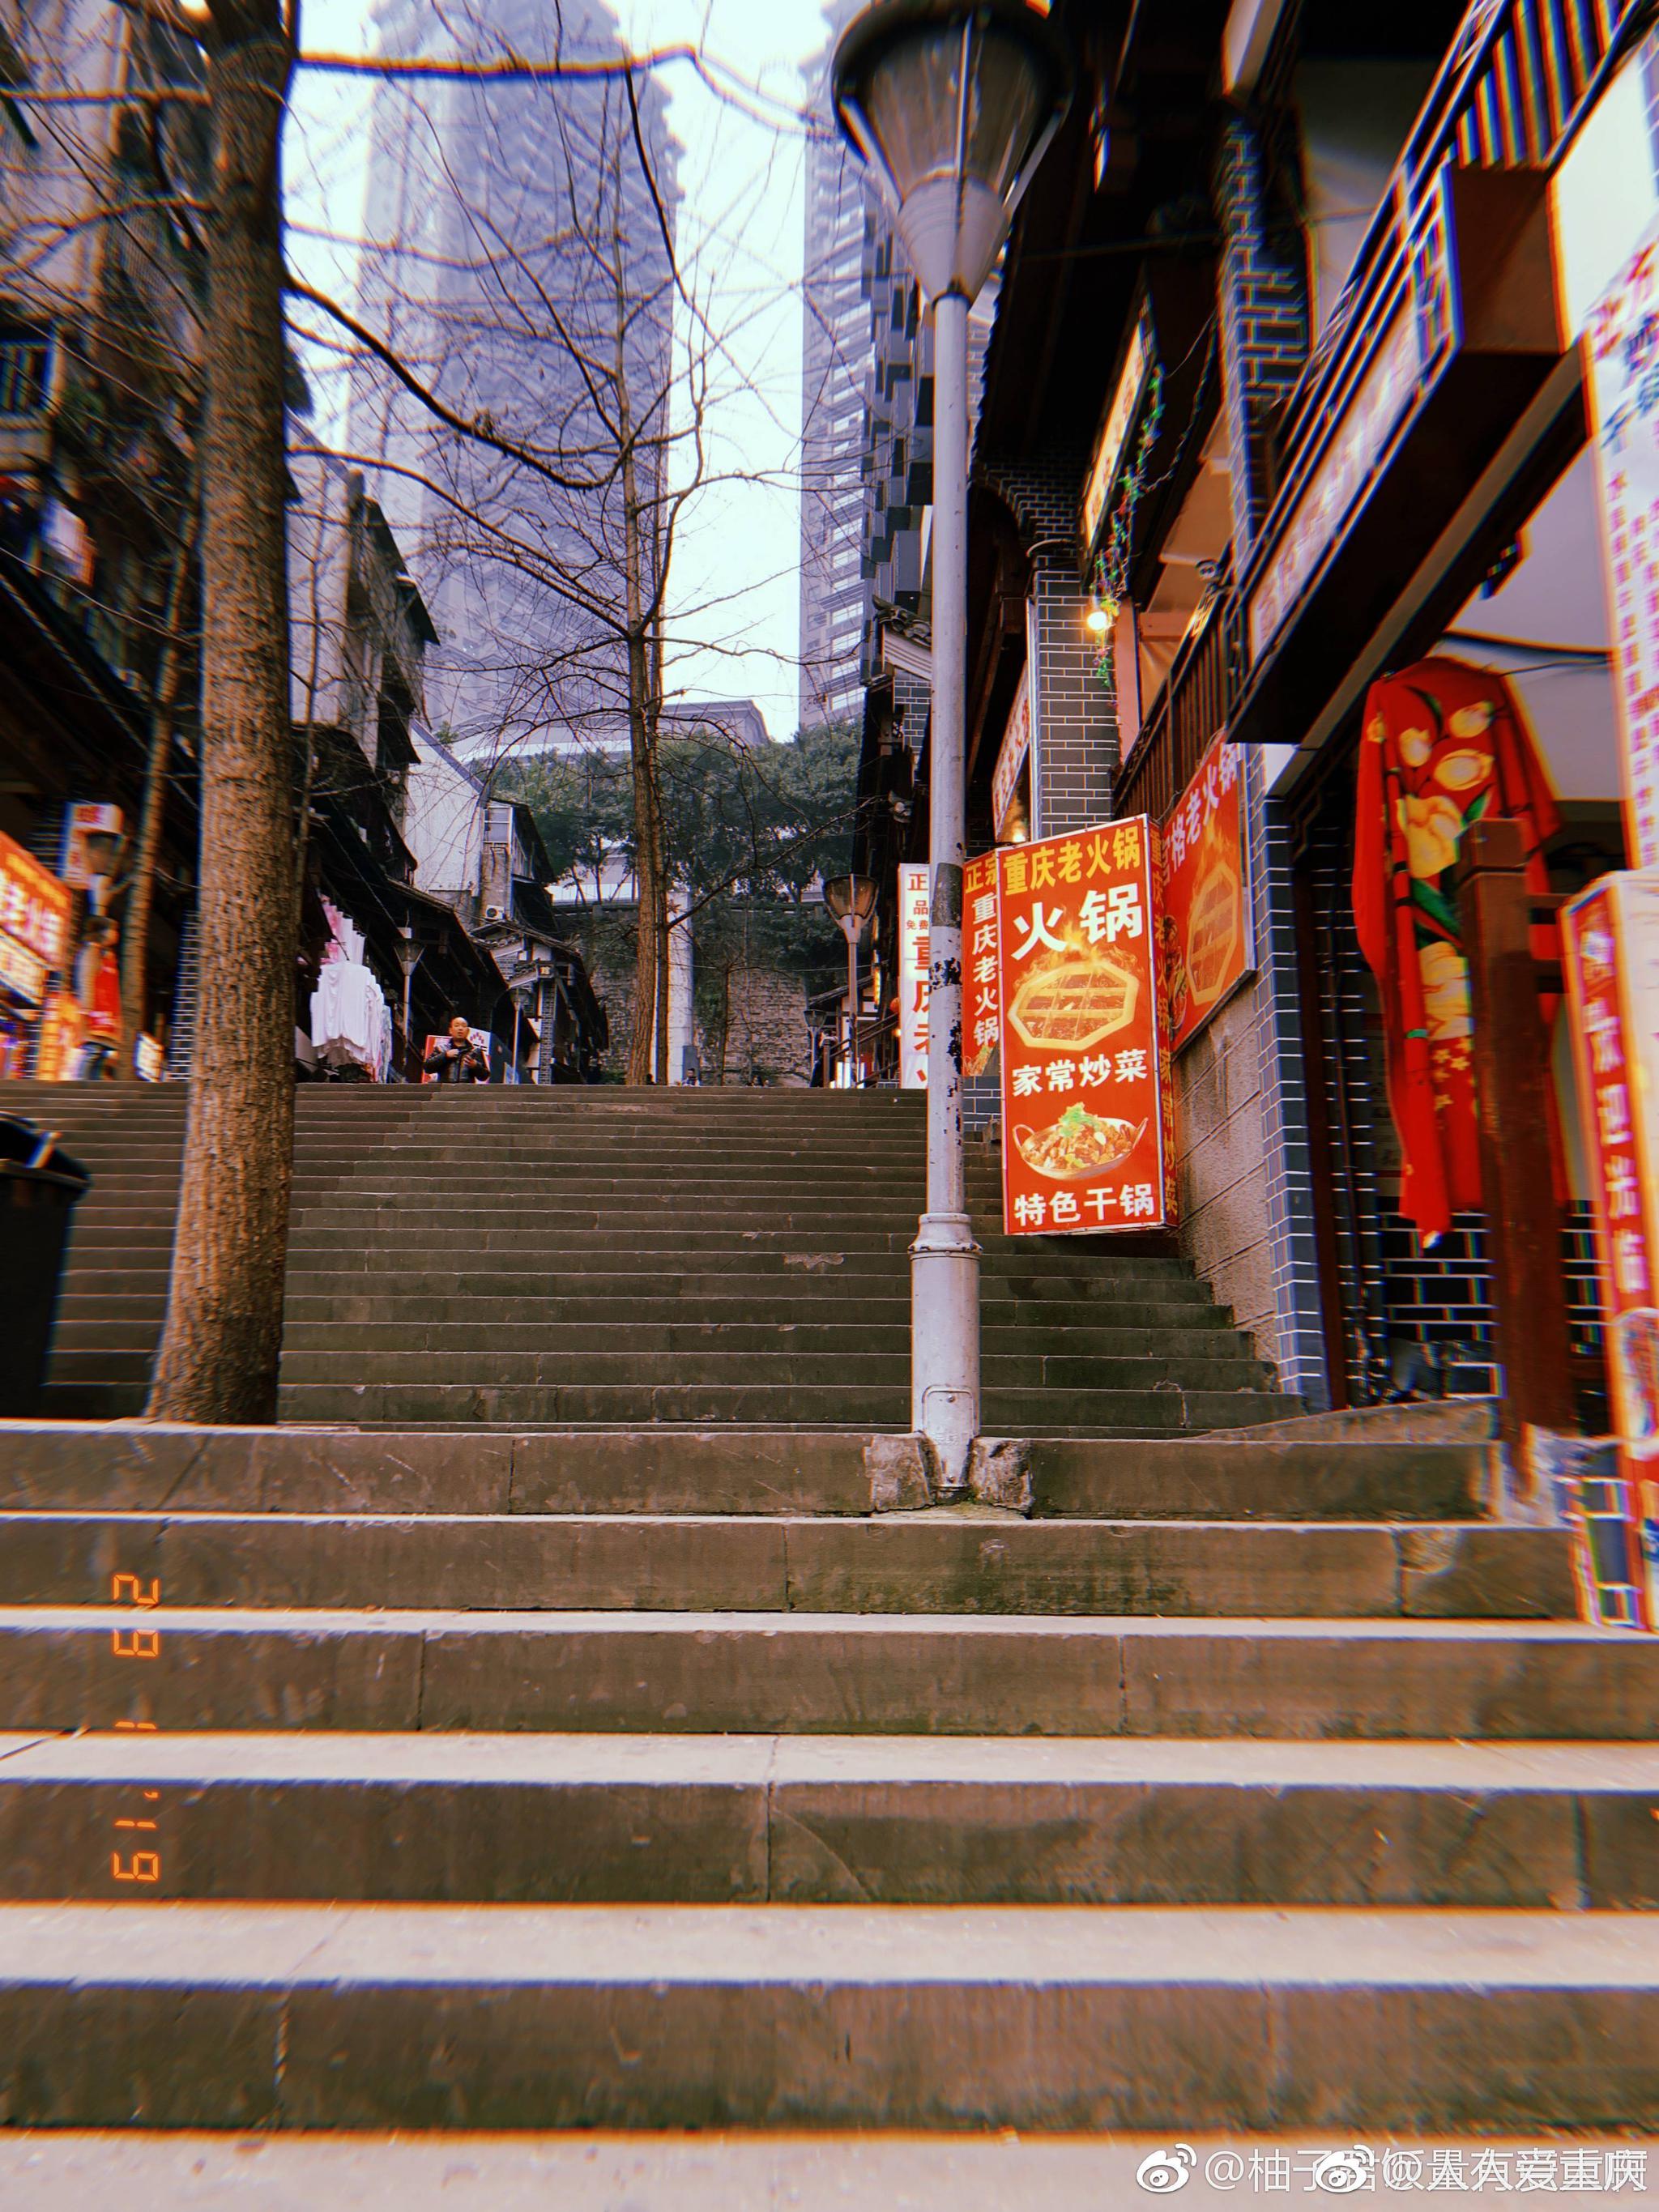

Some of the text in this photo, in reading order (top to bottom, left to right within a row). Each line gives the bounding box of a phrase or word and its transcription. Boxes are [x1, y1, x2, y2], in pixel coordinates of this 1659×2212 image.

[1004, 825, 1141, 897] 重庆老火锅
[1010, 882, 1144, 961] 火锅
[972, 892, 1000, 1047] 重庆老火锅
[1012, 1050, 1148, 1097] 家常炒菜
[1014, 1184, 1154, 1227] 特色干锅
